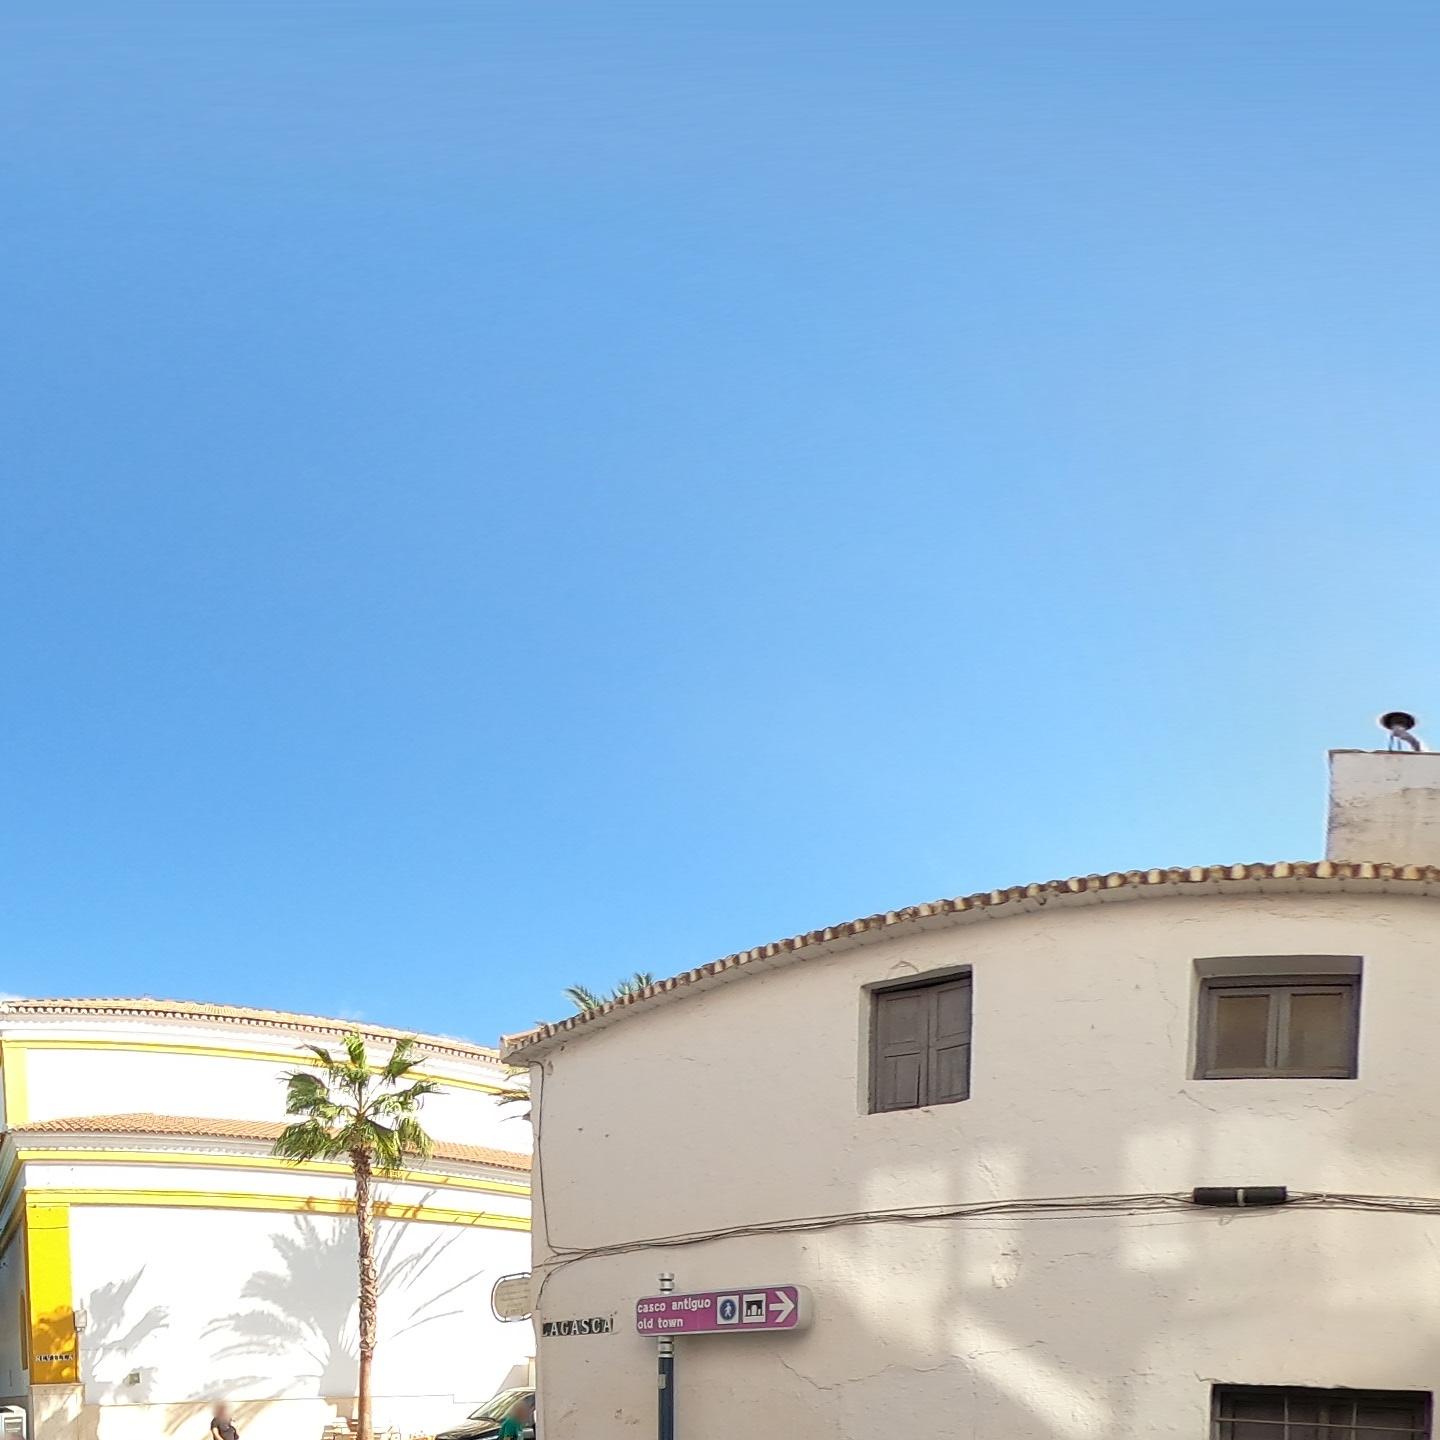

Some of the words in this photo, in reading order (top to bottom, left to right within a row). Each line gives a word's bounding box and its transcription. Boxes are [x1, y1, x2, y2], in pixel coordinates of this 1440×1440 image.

[637, 1301, 666, 1314] casco
[671, 1298, 711, 1312] antiguo
[637, 1318, 654, 1330] old
[657, 1317, 684, 1330] town
